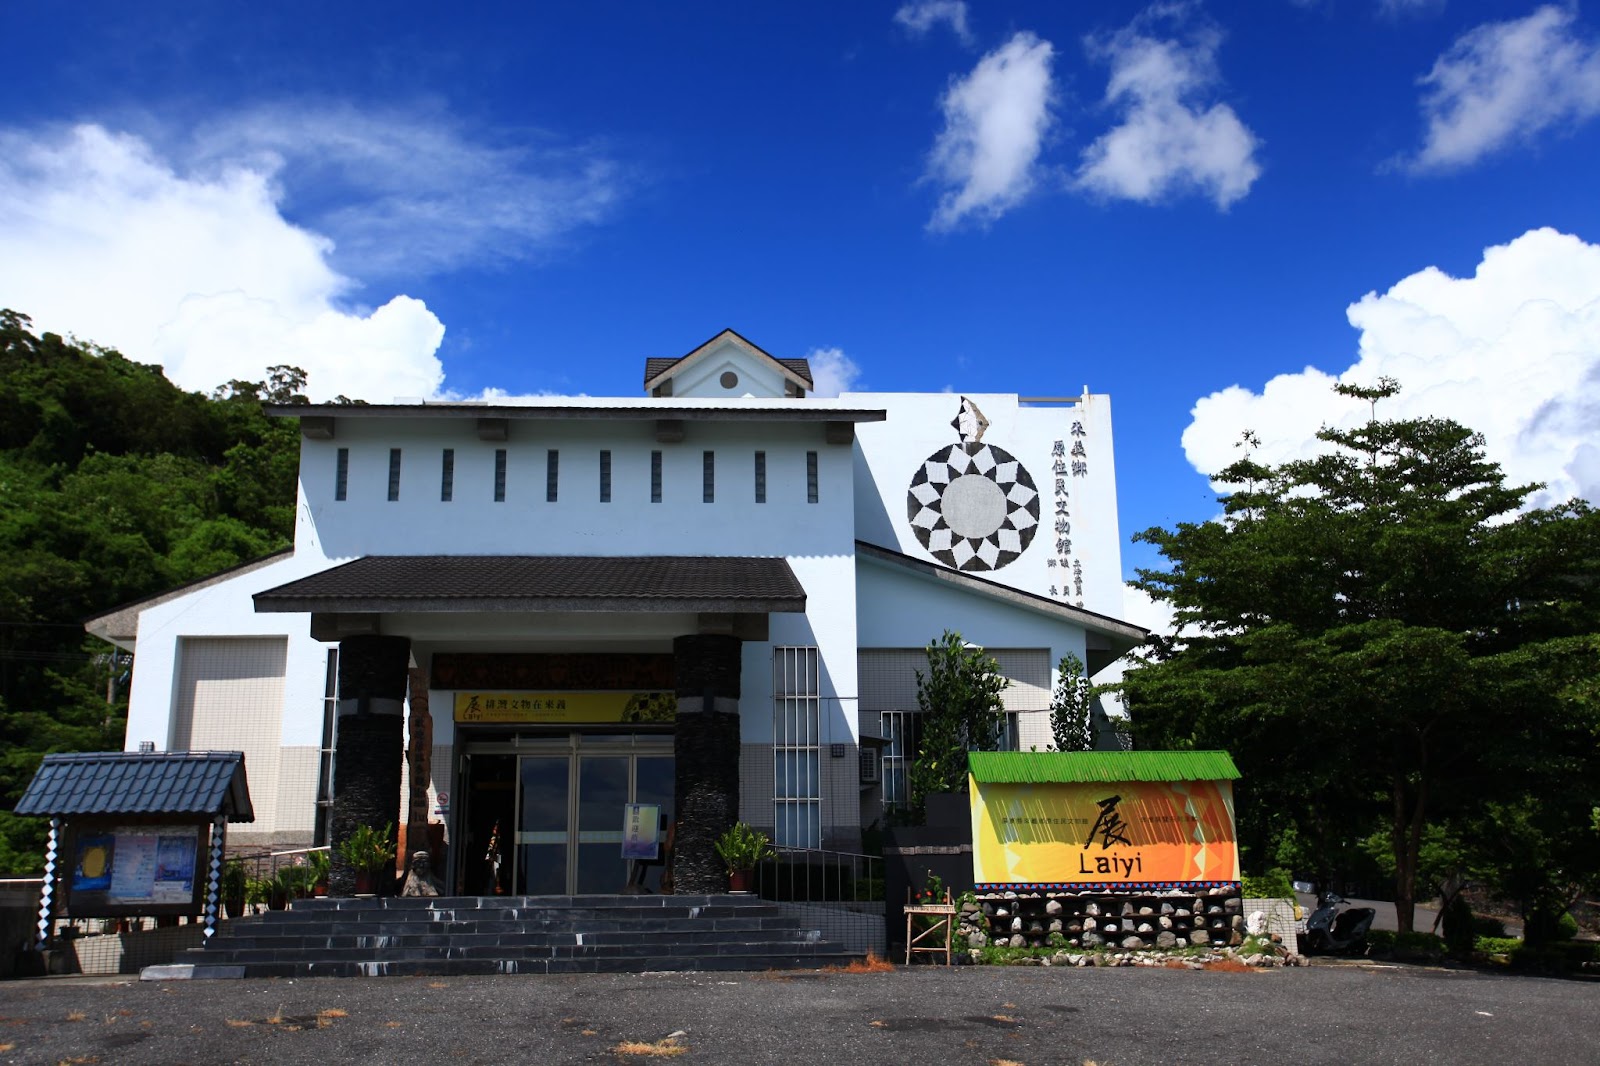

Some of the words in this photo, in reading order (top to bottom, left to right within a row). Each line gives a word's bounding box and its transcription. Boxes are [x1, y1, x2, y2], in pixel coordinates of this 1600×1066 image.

[1051, 440, 1072, 556] 原住民文物館
[486, 699, 567, 710] 排灣文物在來義
[1084, 795, 1132, 850] 展
[1079, 852, 1141, 878] Laiyi
